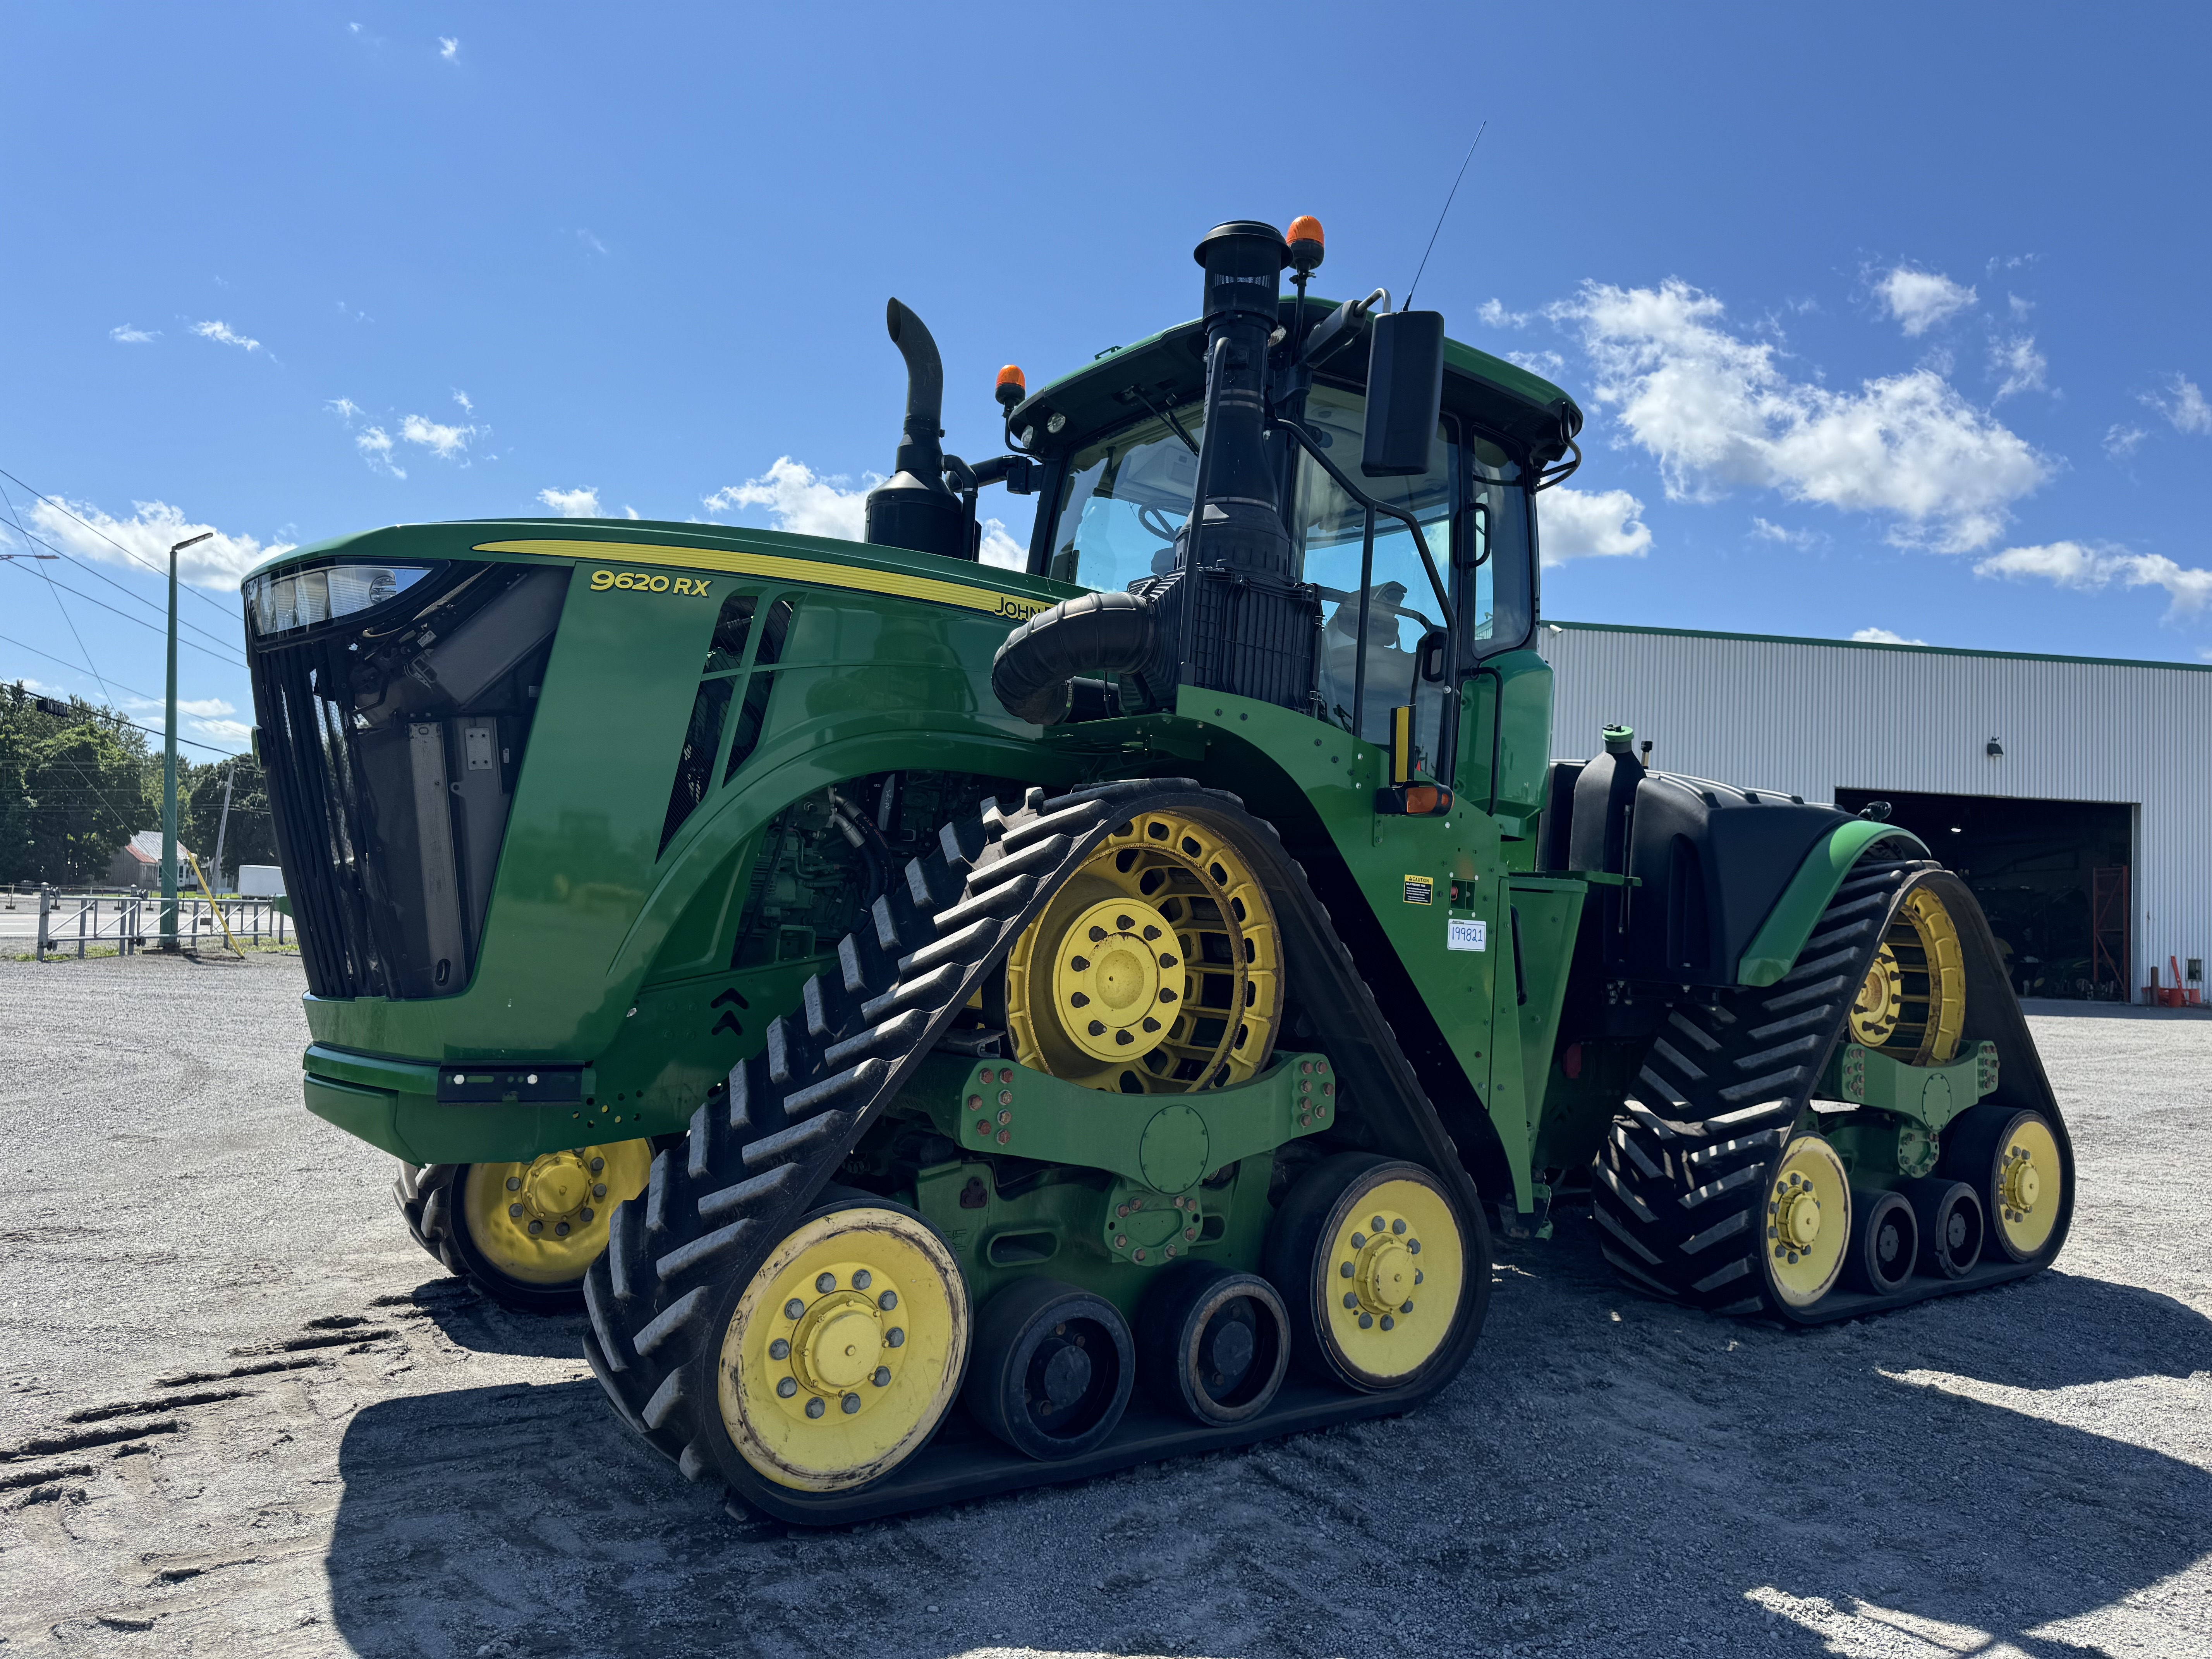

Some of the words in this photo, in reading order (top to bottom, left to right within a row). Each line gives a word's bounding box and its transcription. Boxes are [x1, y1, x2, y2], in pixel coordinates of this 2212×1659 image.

[590, 570, 670, 592] 9620
[673, 577, 712, 597] RX
[994, 597, 1041, 619] JOHN
[1452, 926, 1483, 942] 199821
